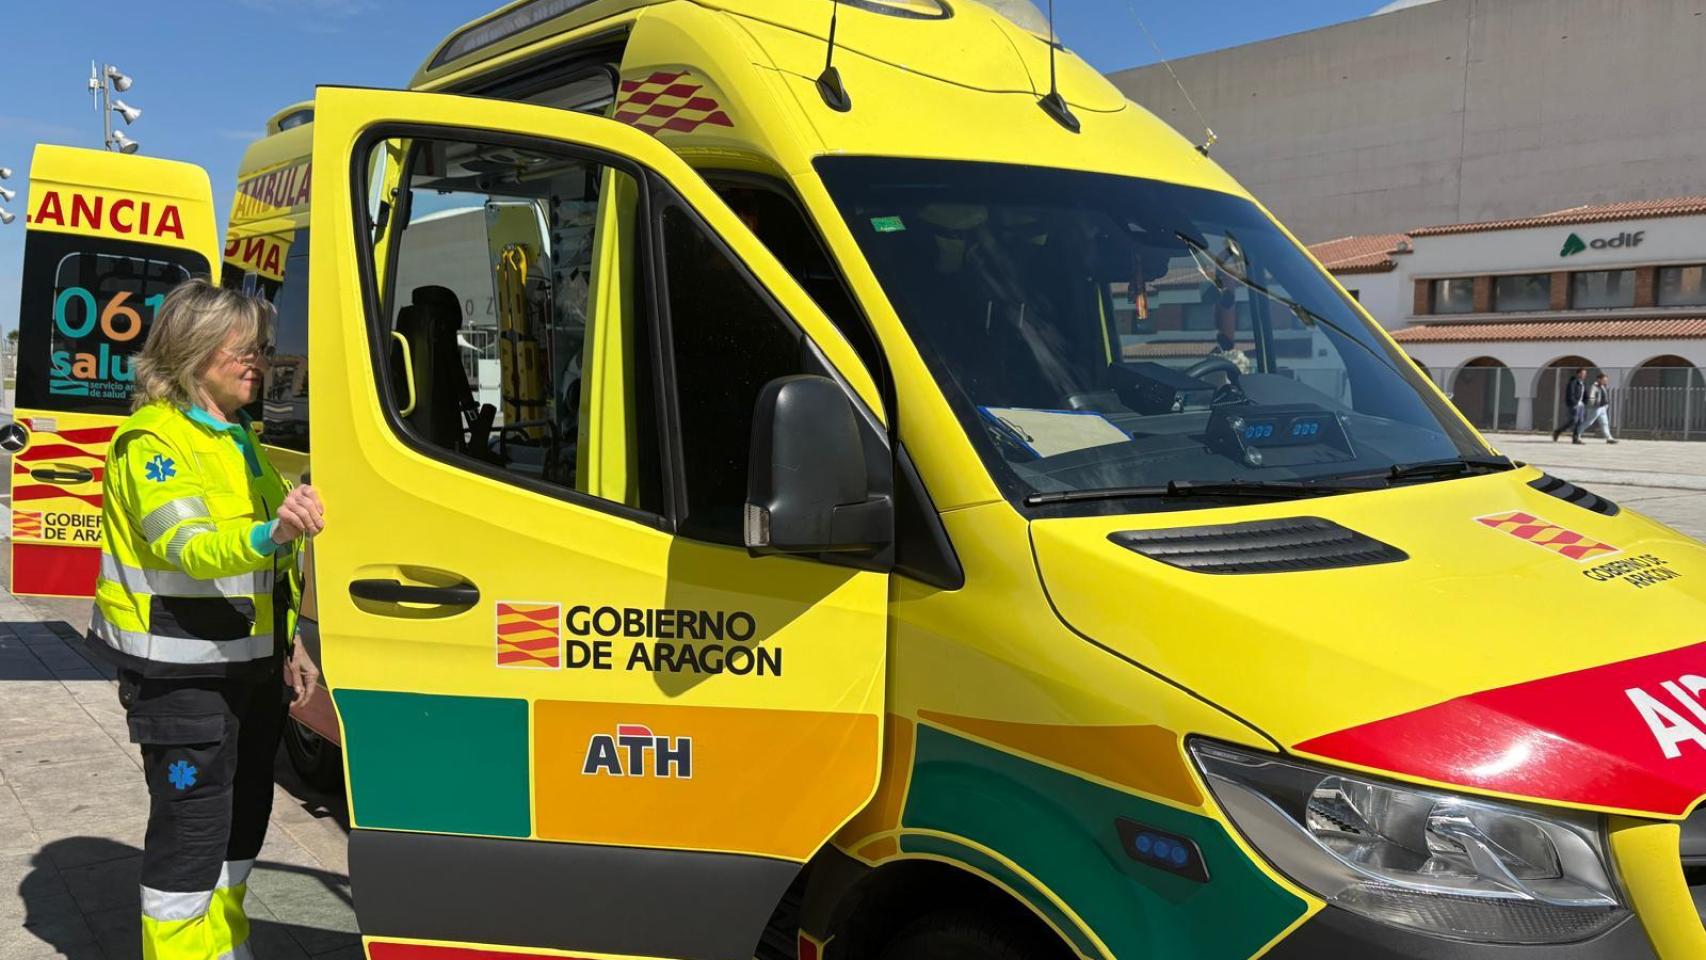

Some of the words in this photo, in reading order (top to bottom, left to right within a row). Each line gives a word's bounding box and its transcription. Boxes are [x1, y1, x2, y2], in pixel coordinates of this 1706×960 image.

[27, 190, 185, 240] ANCIA
[1589, 231, 1645, 250] adif
[50, 343, 136, 382] salu
[90, 382, 123, 391] servicio
[90, 389, 100, 397] de
[102, 389, 126, 399] salud
[45, 527, 66, 540] DE
[1582, 557, 1652, 582] GOBIERNO
[566, 605, 756, 641] GOBIERNO
[566, 640, 612, 670] DE
[626, 642, 782, 677] ARAGON
[582, 725, 692, 779] ATH
